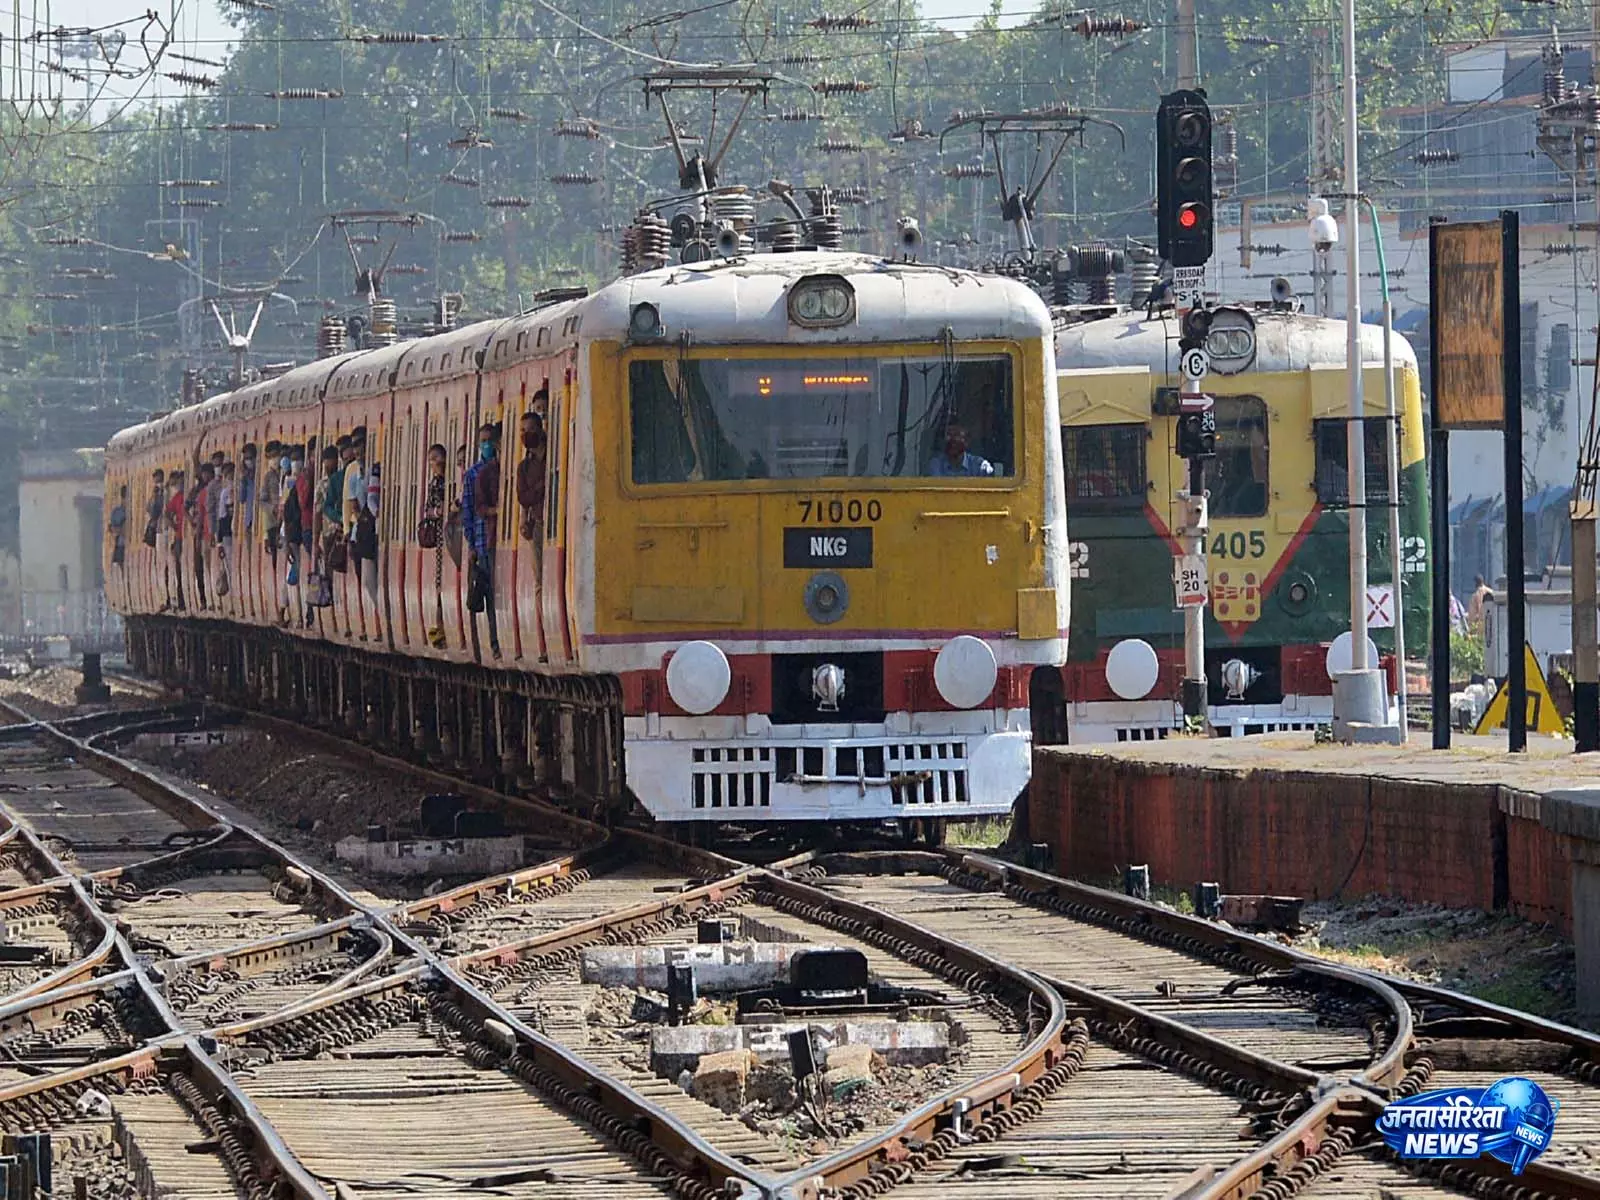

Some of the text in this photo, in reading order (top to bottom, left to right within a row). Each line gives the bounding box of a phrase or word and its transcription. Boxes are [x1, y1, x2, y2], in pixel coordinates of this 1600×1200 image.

[1202, 411, 1214, 420] SH
[1202, 420, 1215, 431] 20
[798, 500, 882, 523] 71000
[810, 537, 848, 557] NKG
[1182, 570, 1199, 580] SH
[1183, 581, 1200, 592] 20
